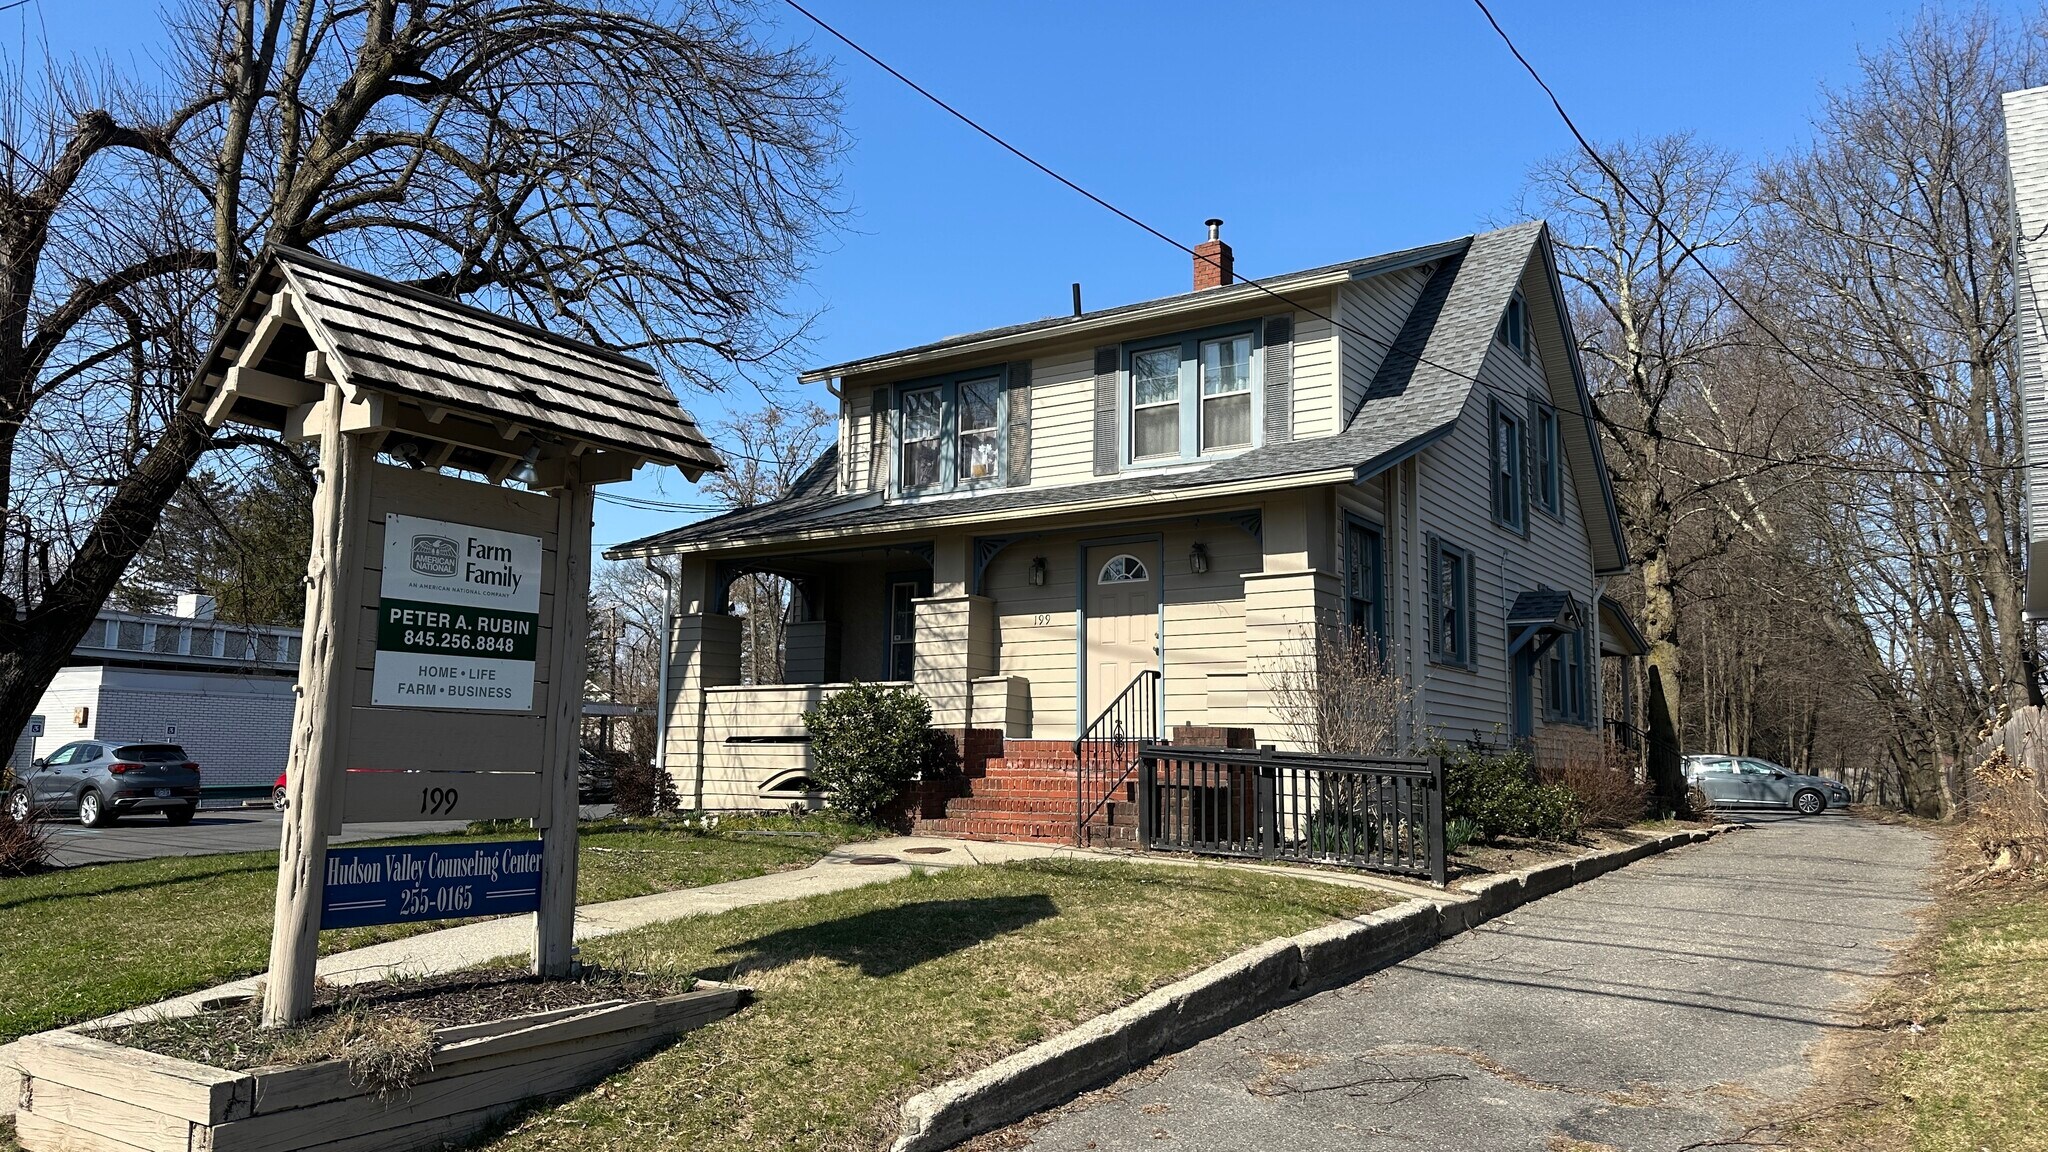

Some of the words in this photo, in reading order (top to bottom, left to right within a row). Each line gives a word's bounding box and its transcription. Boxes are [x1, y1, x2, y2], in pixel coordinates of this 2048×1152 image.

[415, 555, 455, 566] AMERICAN
[467, 537, 512, 562] Farm
[416, 562, 453, 573] NATIONAL
[465, 562, 522, 594] Family
[452, 587, 481, 595] NATIONAL
[390, 608, 450, 629] PETER
[455, 615, 472, 630] A.
[477, 617, 530, 635] RUBIN
[1034, 614, 1051, 626] 199
[404, 630, 514, 652] 845.256.8848
[418, 666, 458, 678] HOME
[469, 669, 496, 680] LIFE
[398, 683, 436, 695] FARM
[448, 685, 512, 698] BUSINESS
[420, 787, 459, 815] 199
[327, 857, 381, 886] Hudson
[385, 854, 426, 887] Valley
[428, 850, 499, 882] Counseling
[502, 848, 543, 875] Center
[400, 885, 473, 915] 255-0165
